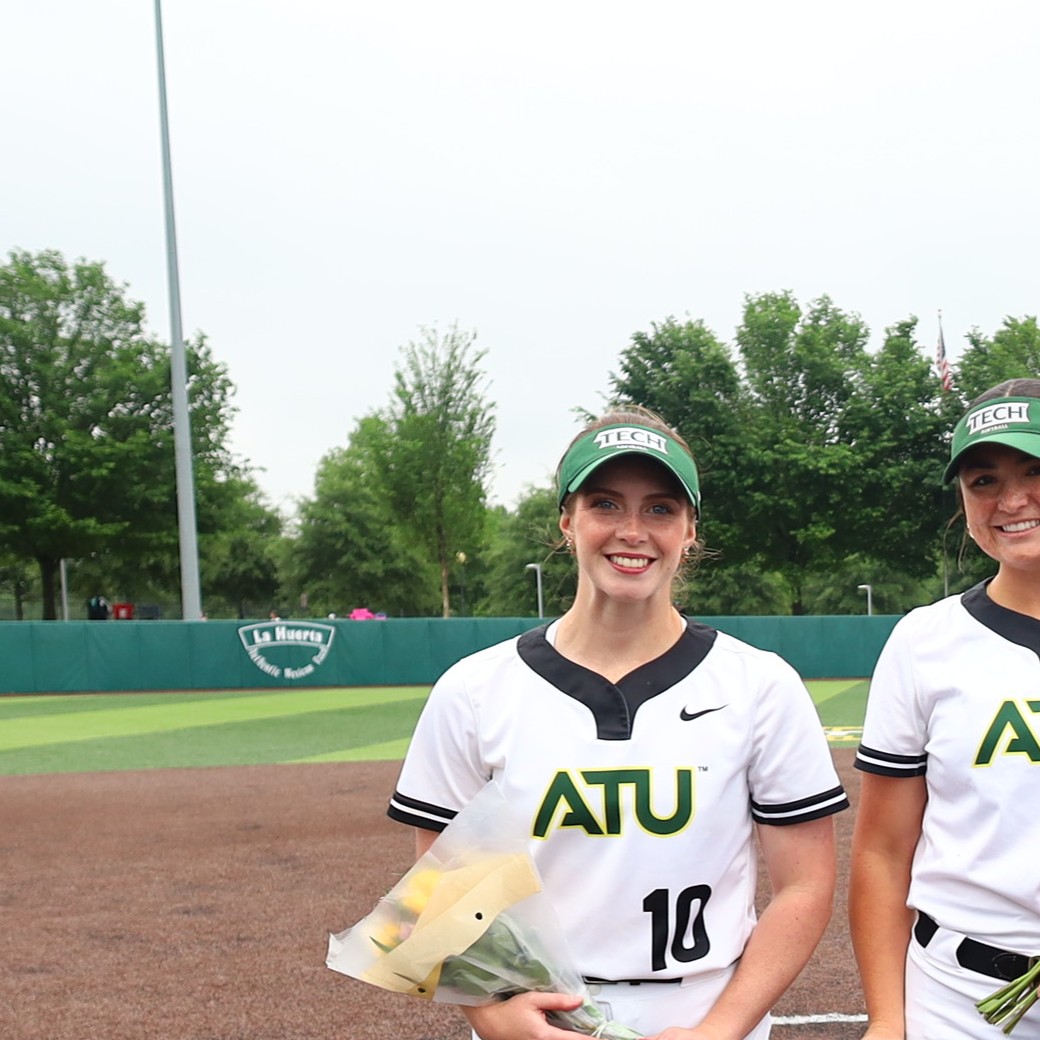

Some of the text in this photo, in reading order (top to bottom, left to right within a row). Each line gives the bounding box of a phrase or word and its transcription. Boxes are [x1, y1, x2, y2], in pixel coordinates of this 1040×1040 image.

[970, 405, 1023, 430] TECH
[601, 430, 662, 449] TECH
[253, 626, 323, 644] La Huerta
[530, 766, 695, 841] ATU
[642, 884, 712, 972] 10
